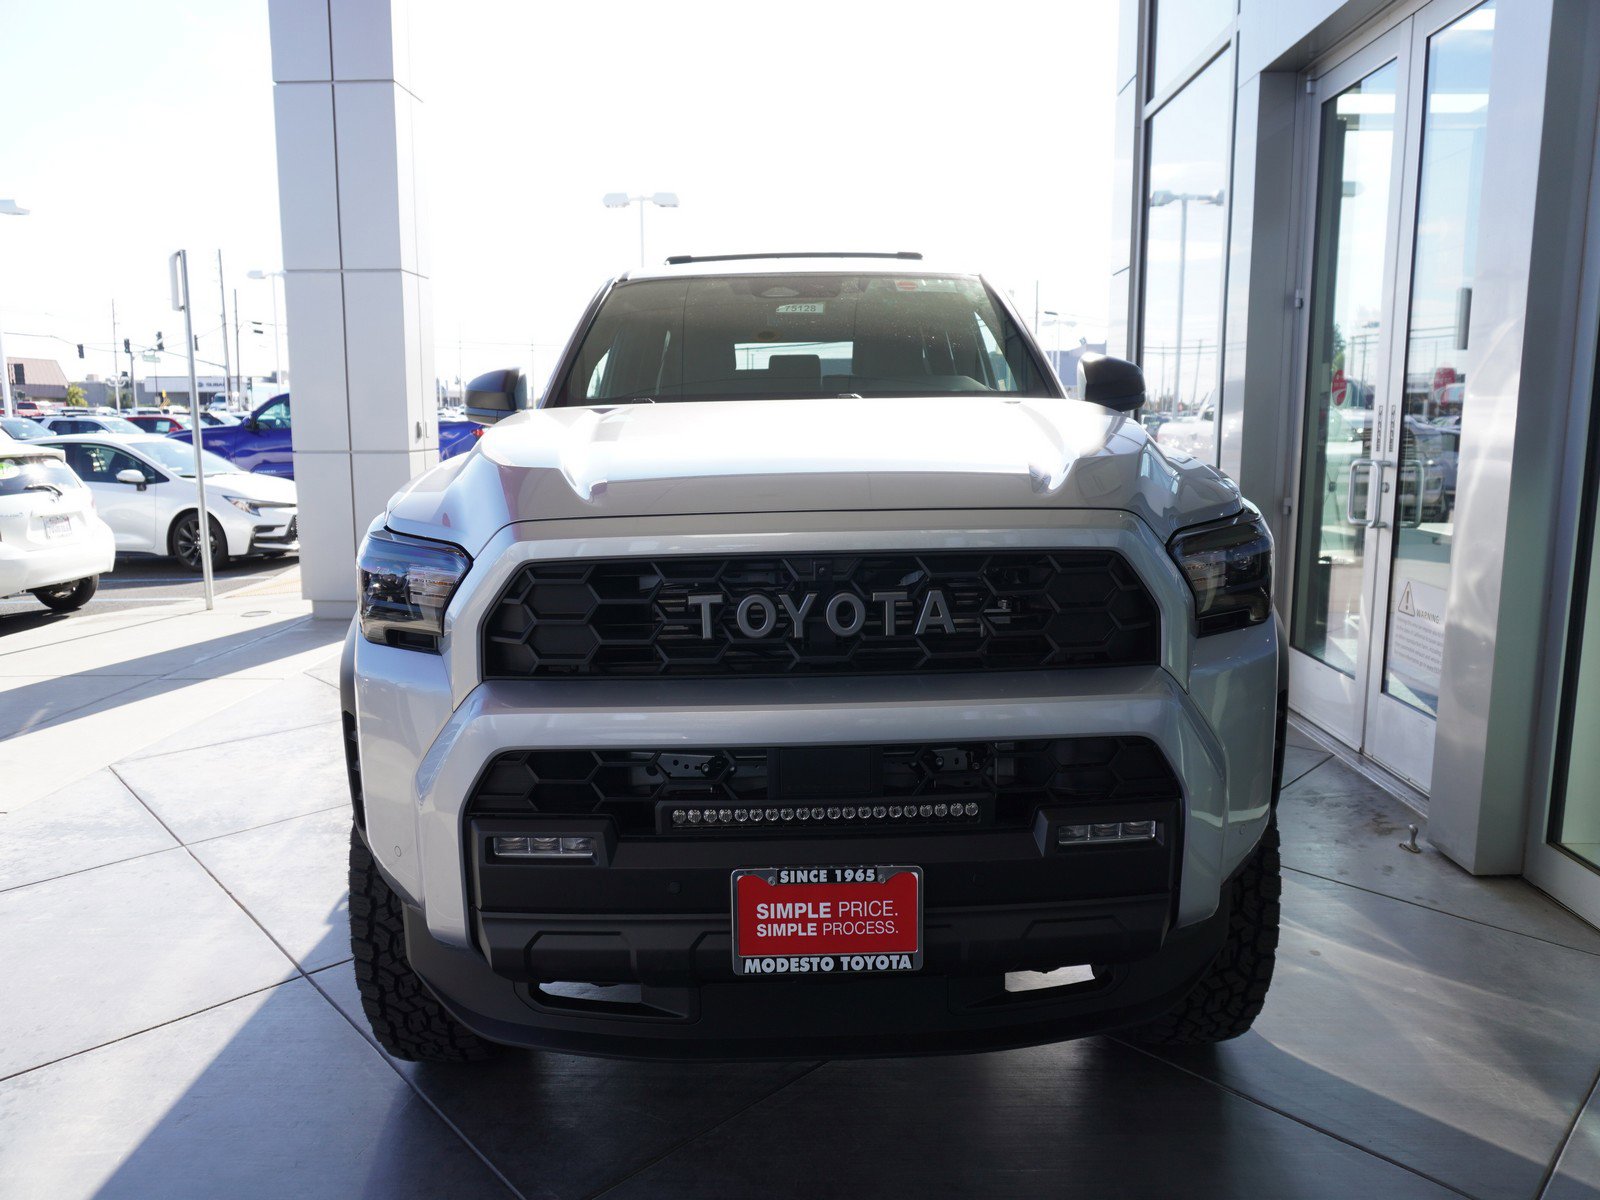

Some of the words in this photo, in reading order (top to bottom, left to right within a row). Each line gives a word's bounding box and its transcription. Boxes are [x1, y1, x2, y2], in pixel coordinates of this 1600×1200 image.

[688, 590, 957, 640] TOYOTA
[780, 869, 828, 884] SINCE
[835, 868, 875, 883] 1965
[756, 902, 832, 919] SIMPLE
[838, 900, 899, 918] PRICE.
[756, 922, 818, 937] SIMPLE
[822, 920, 899, 936] PROCESS.
[744, 956, 835, 974] MODESTO
[840, 954, 912, 972] TOYOTA
